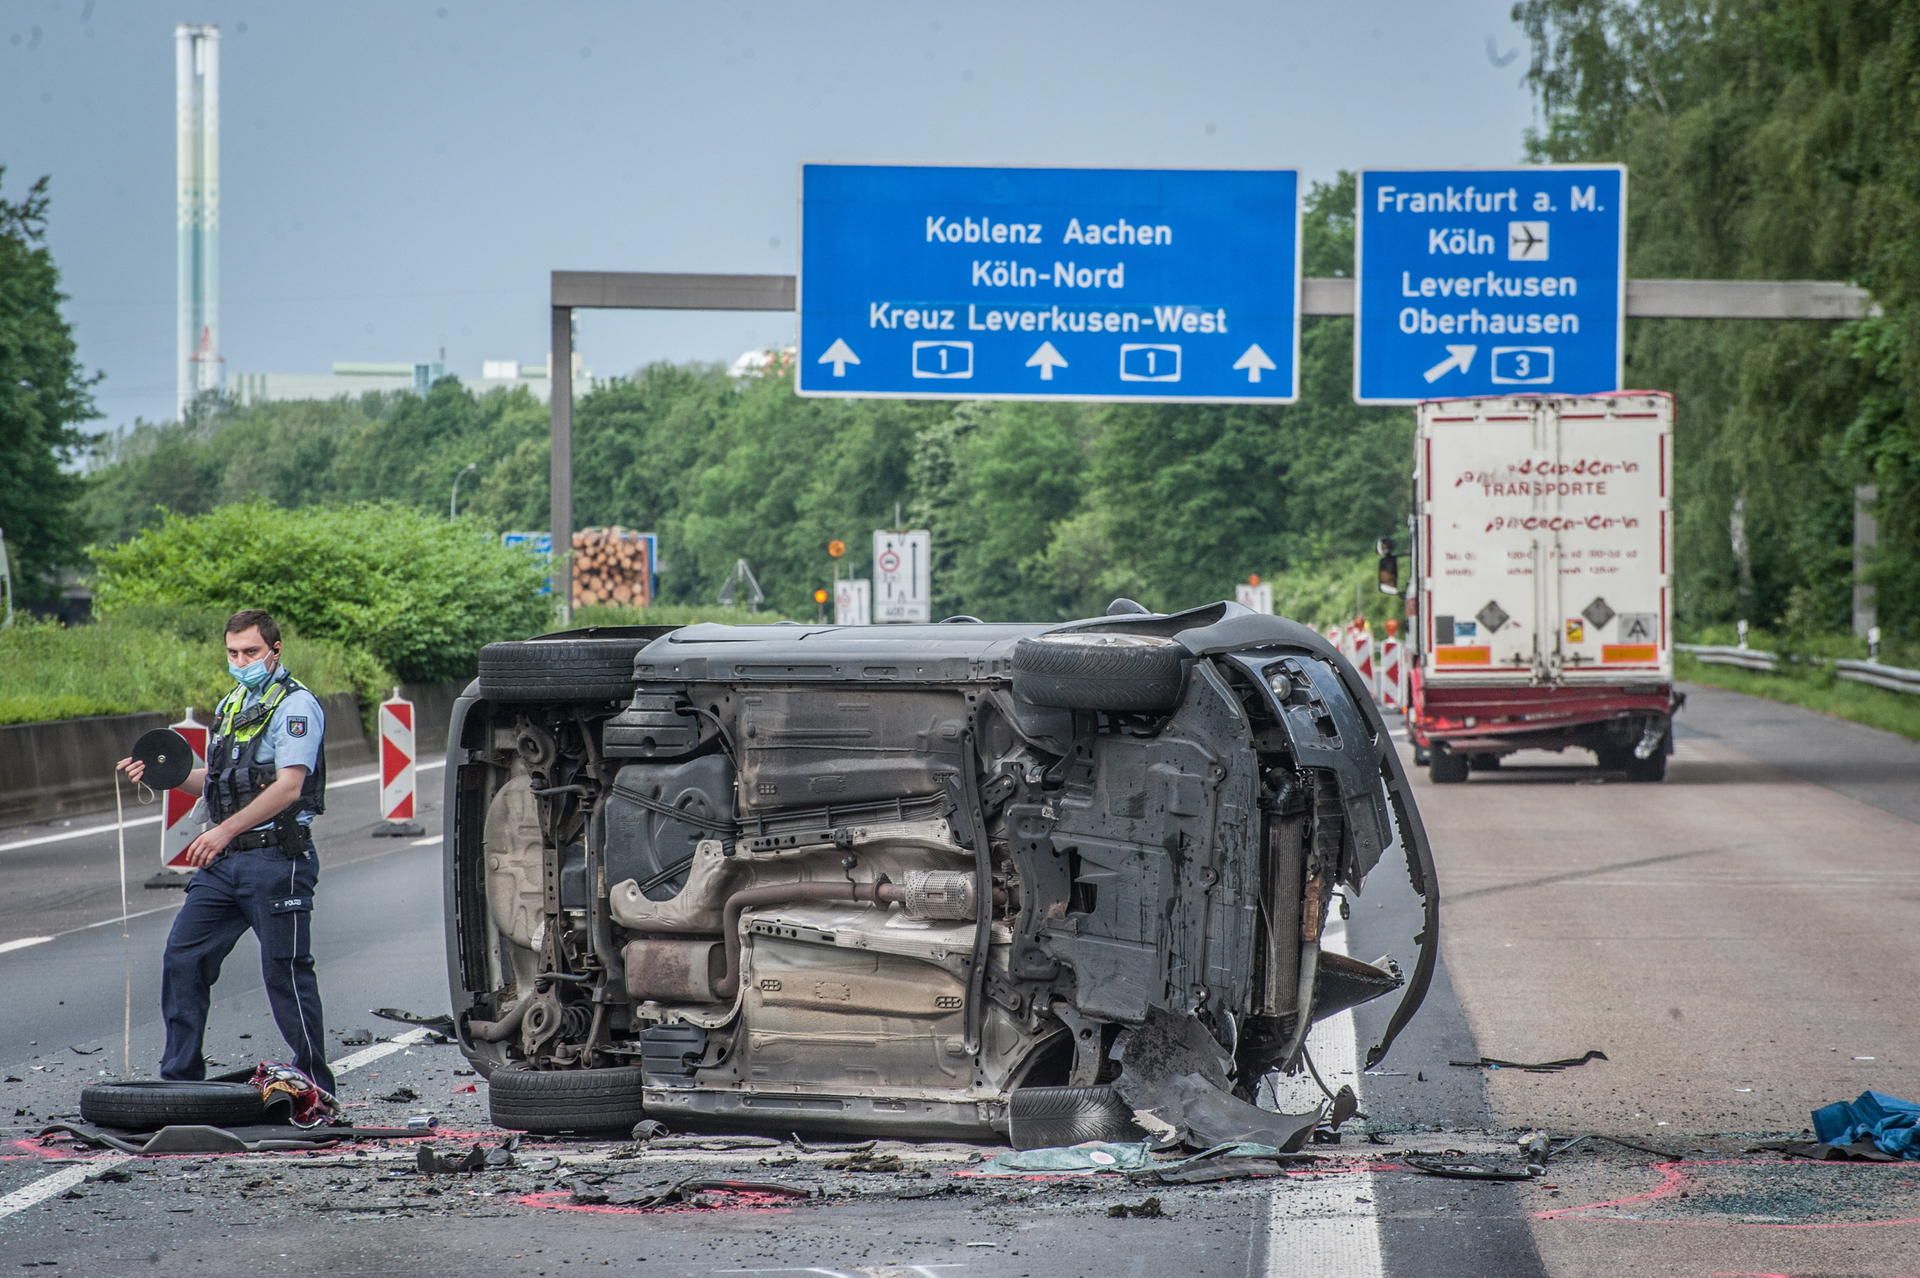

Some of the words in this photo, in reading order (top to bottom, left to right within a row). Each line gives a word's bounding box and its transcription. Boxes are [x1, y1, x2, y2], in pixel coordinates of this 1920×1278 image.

[1377, 186, 1518, 213] Frankfurt
[1532, 192, 1557, 212] a.
[1571, 185, 1604, 212] M.
[926, 216, 1042, 243] Koblenz
[1063, 218, 1172, 245] Aachen
[1428, 228, 1495, 255] Köln
[972, 260, 1125, 288] Köln-Nord
[1402, 271, 1577, 297] Leverkusen
[869, 302, 955, 329] Kreuz
[968, 303, 1228, 333] Leverkusen-West
[1399, 307, 1579, 334] Oberhausen
[938, 349, 948, 371] 1
[1146, 352, 1156, 374] 1
[1515, 354, 1530, 377] 3
[1484, 481, 1607, 496] TRANSPORTE
